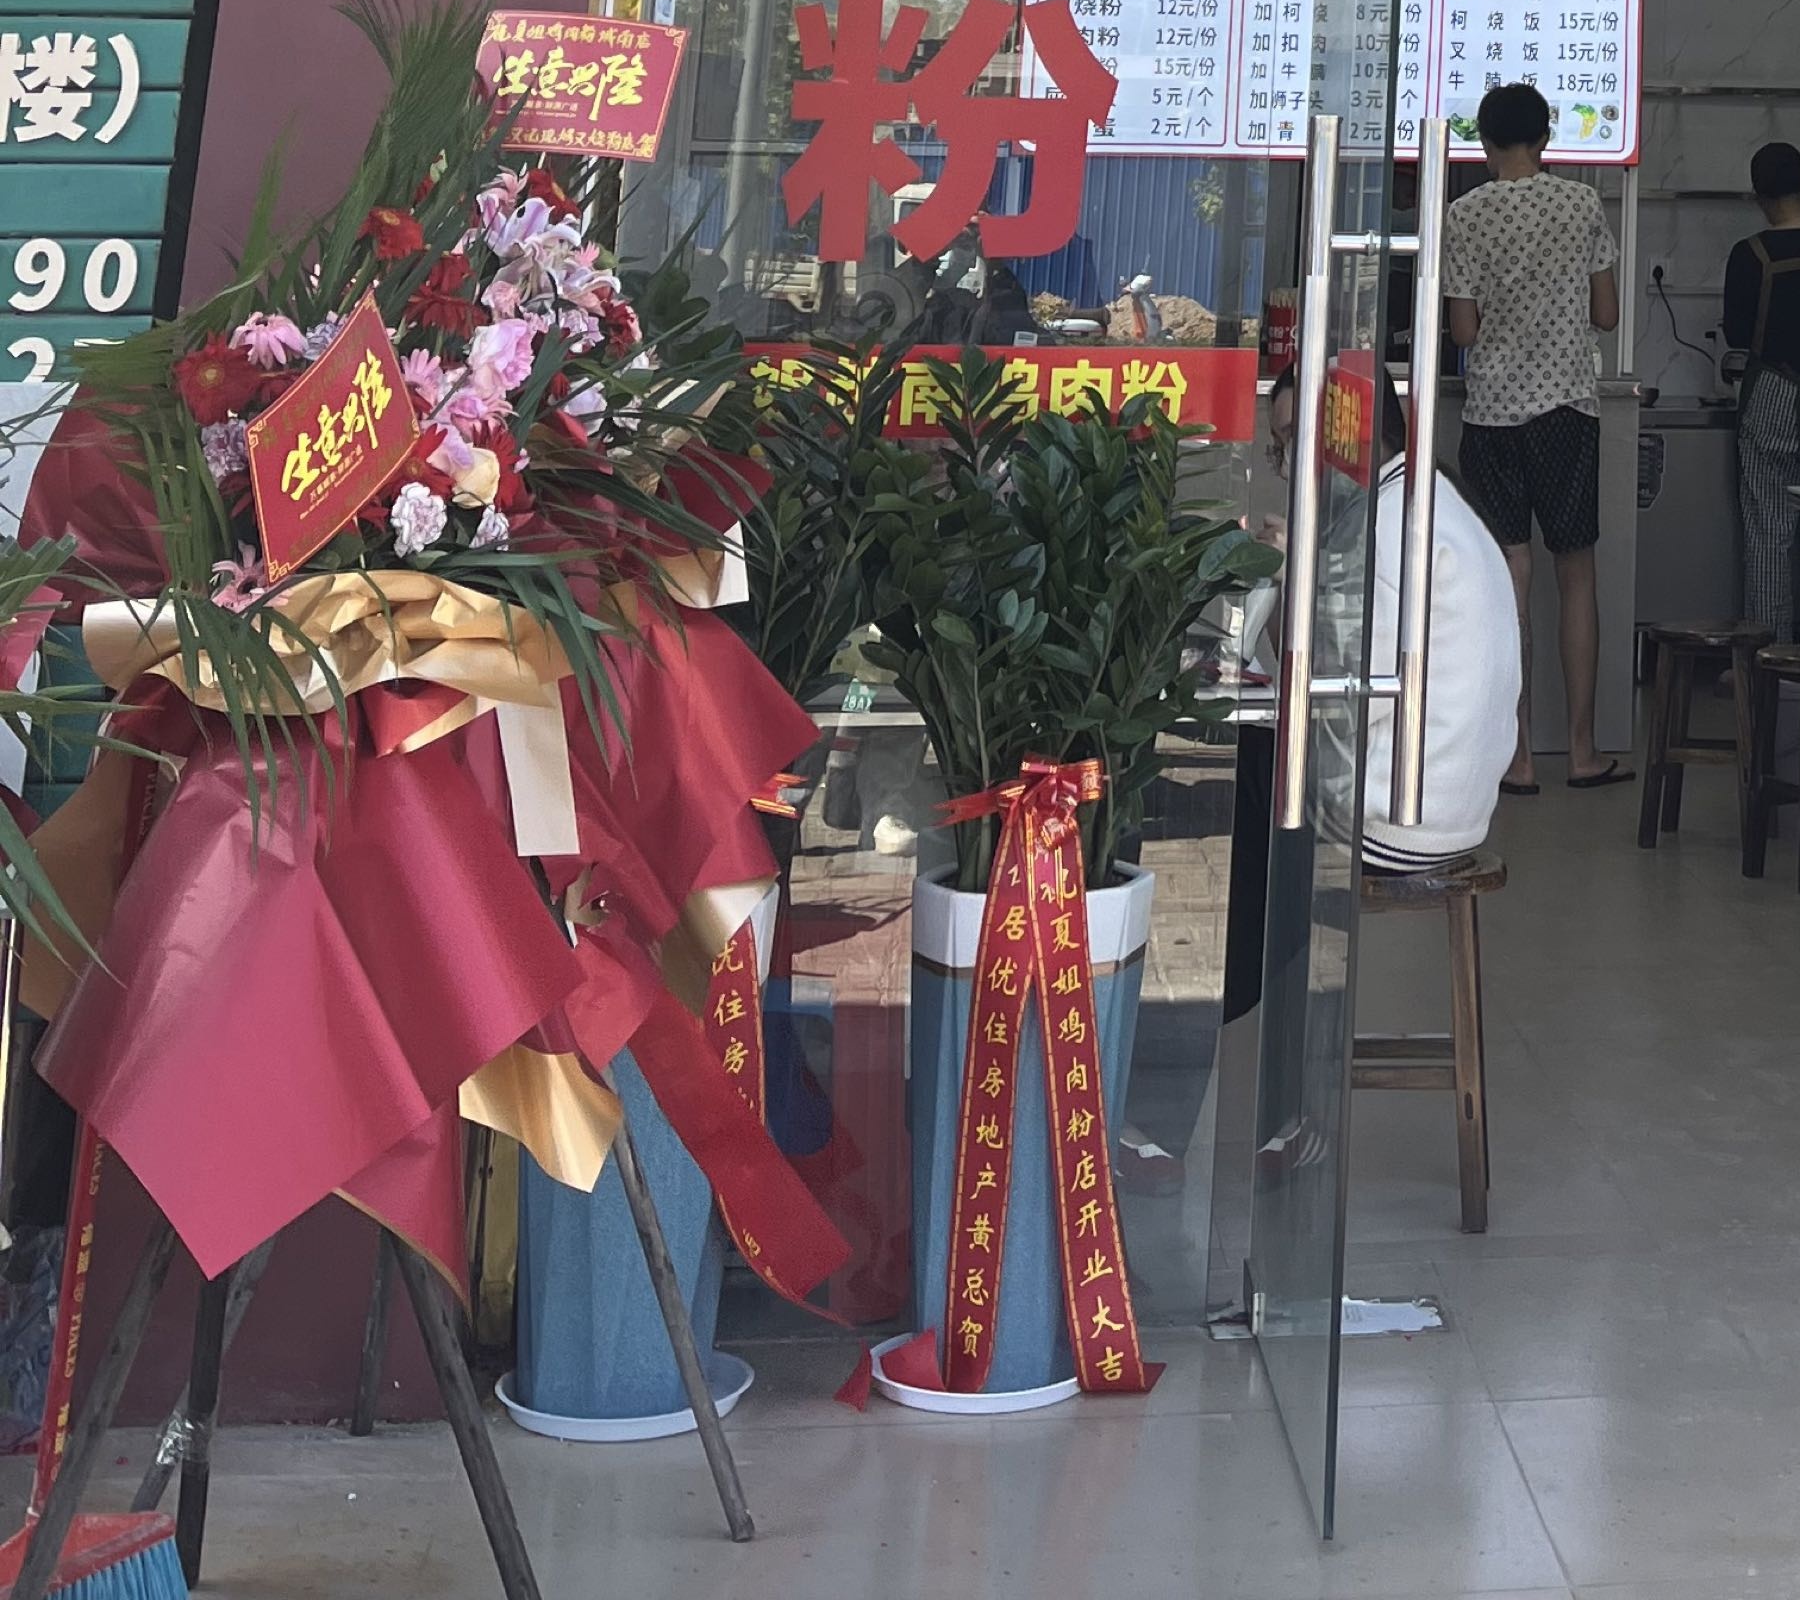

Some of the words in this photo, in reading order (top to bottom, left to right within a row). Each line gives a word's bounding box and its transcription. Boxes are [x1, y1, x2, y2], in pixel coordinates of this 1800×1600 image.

[1558, 12, 1619, 33] 15元/份
[1080, 26, 1121, 47] 肉粉
[1155, 26, 1218, 48] 12元/份
[1557, 42, 1619, 64] 15元/份
[1154, 56, 1216, 78] 15元/份
[1556, 73, 1618, 94] 18元/份
